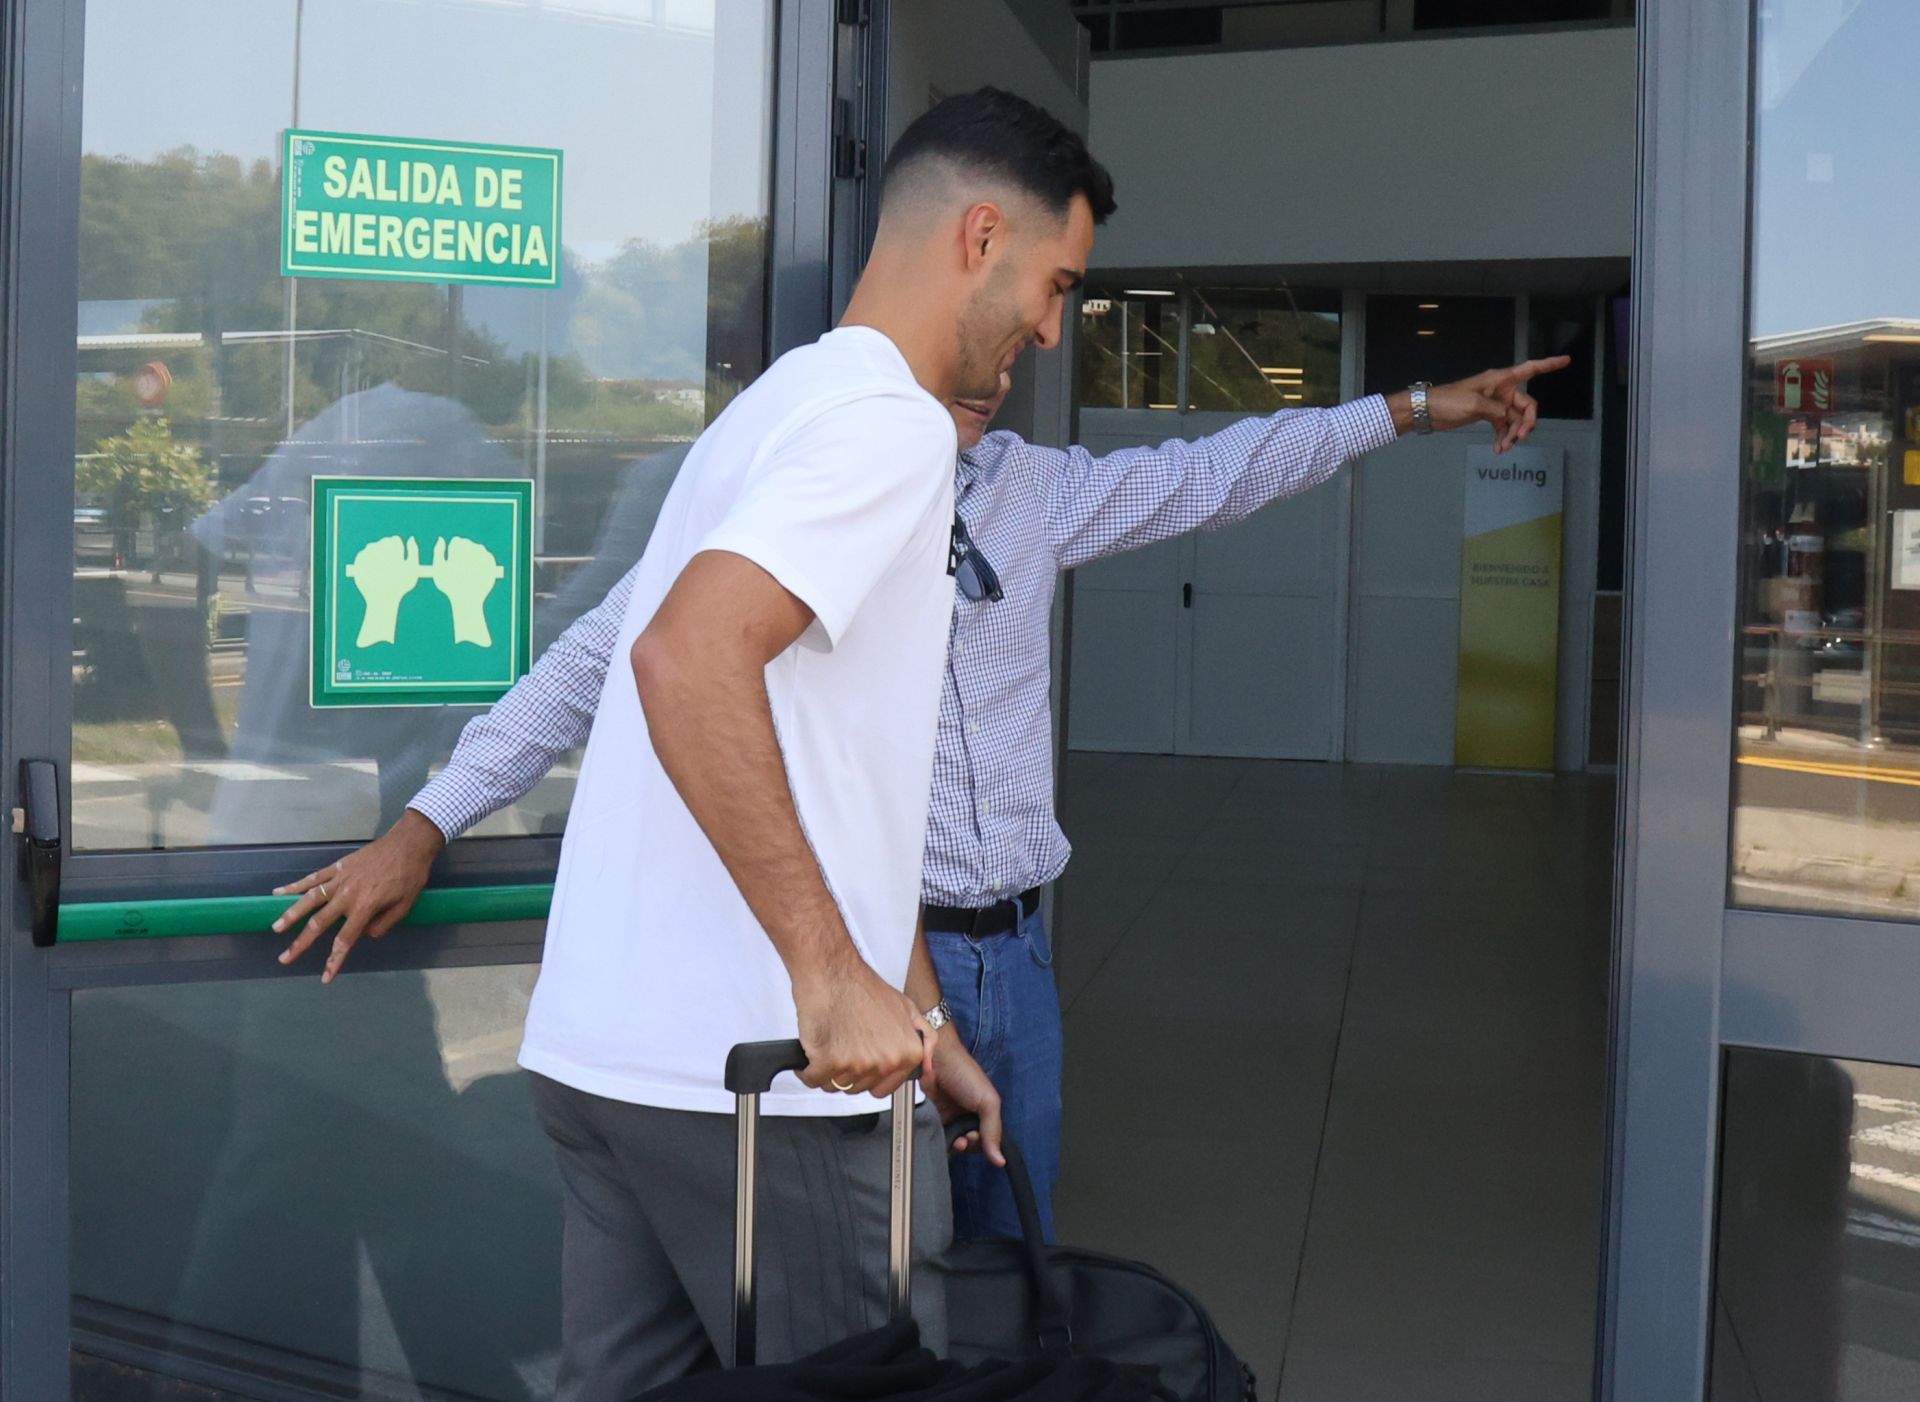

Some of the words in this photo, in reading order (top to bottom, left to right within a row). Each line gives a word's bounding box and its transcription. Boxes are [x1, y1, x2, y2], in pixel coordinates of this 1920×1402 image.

[322, 154, 463, 207] SALIDA
[474, 165, 523, 210] DE
[294, 209, 550, 267] EMERGENCIA
[1478, 462, 1547, 488] vueling
